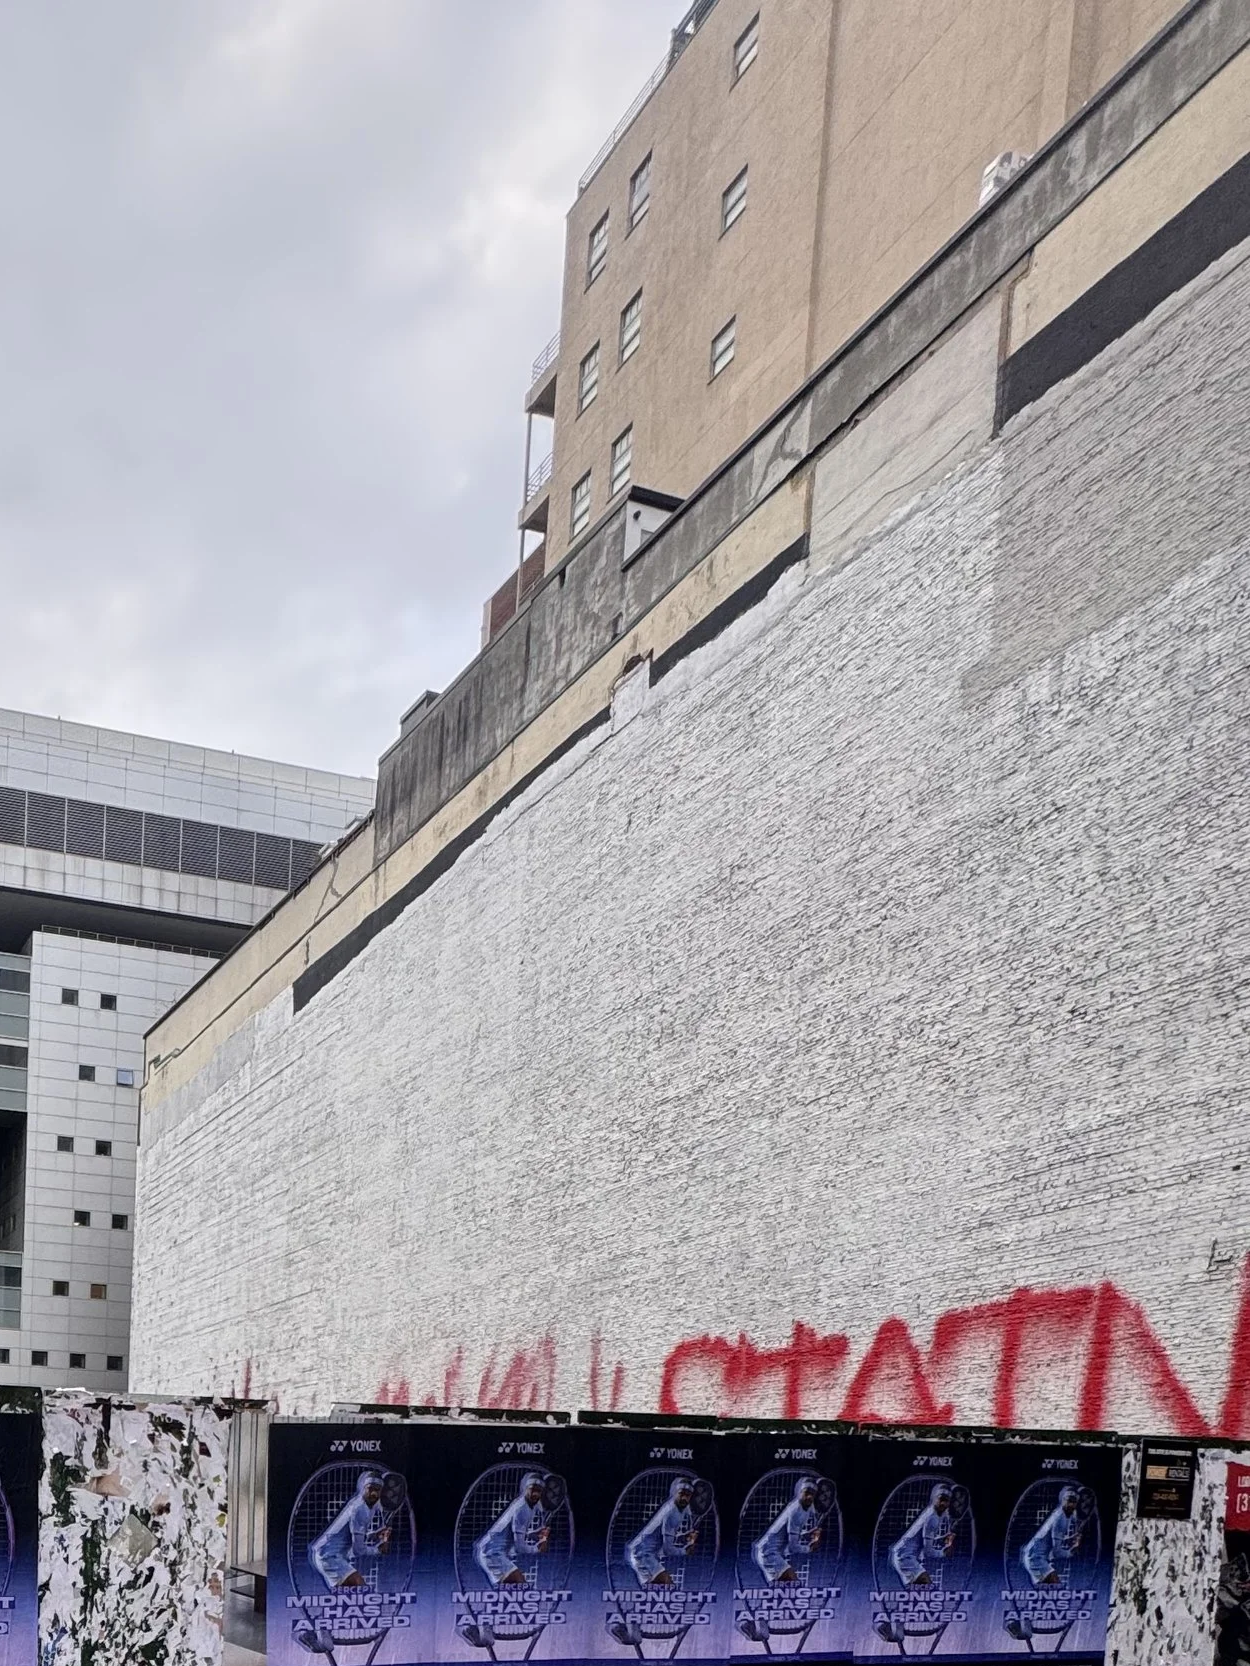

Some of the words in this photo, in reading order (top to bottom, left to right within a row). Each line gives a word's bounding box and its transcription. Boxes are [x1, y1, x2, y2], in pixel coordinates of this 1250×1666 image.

[350, 1440, 381, 1452] YONEX
[516, 1442, 545, 1454] YONEX
[667, 1448, 693, 1459] YONEX
[791, 1449, 817, 1459] YONEX
[929, 1456, 952, 1466] YONEX
[1056, 1459, 1079, 1469] YONEX
[452, 1591, 571, 1602] MIDNIGHT
[603, 1591, 716, 1602] MIDNIGHT
[734, 1587, 840, 1599] MIDNIGHT
[870, 1592, 972, 1601] MIDNIGHT
[1002, 1590, 1095, 1600] MIDNIGHT
[287, 1593, 415, 1607] MIDNIGHT
[763, 1599, 808, 1609] HAS
[1028, 1601, 1069, 1610] HAS
[324, 1606, 380, 1618] HAS
[485, 1602, 538, 1613] HAS
[635, 1603, 684, 1613] HAS
[900, 1602, 943, 1611] HAS
[457, 1613, 566, 1625] ARRIVED
[607, 1613, 709, 1624] ARRIVED
[736, 1609, 834, 1621] ARRIVED
[874, 1612, 966, 1622] ARRIVED
[1005, 1611, 1090, 1620] ARRIVED
[293, 1616, 410, 1631] ARRIVED
